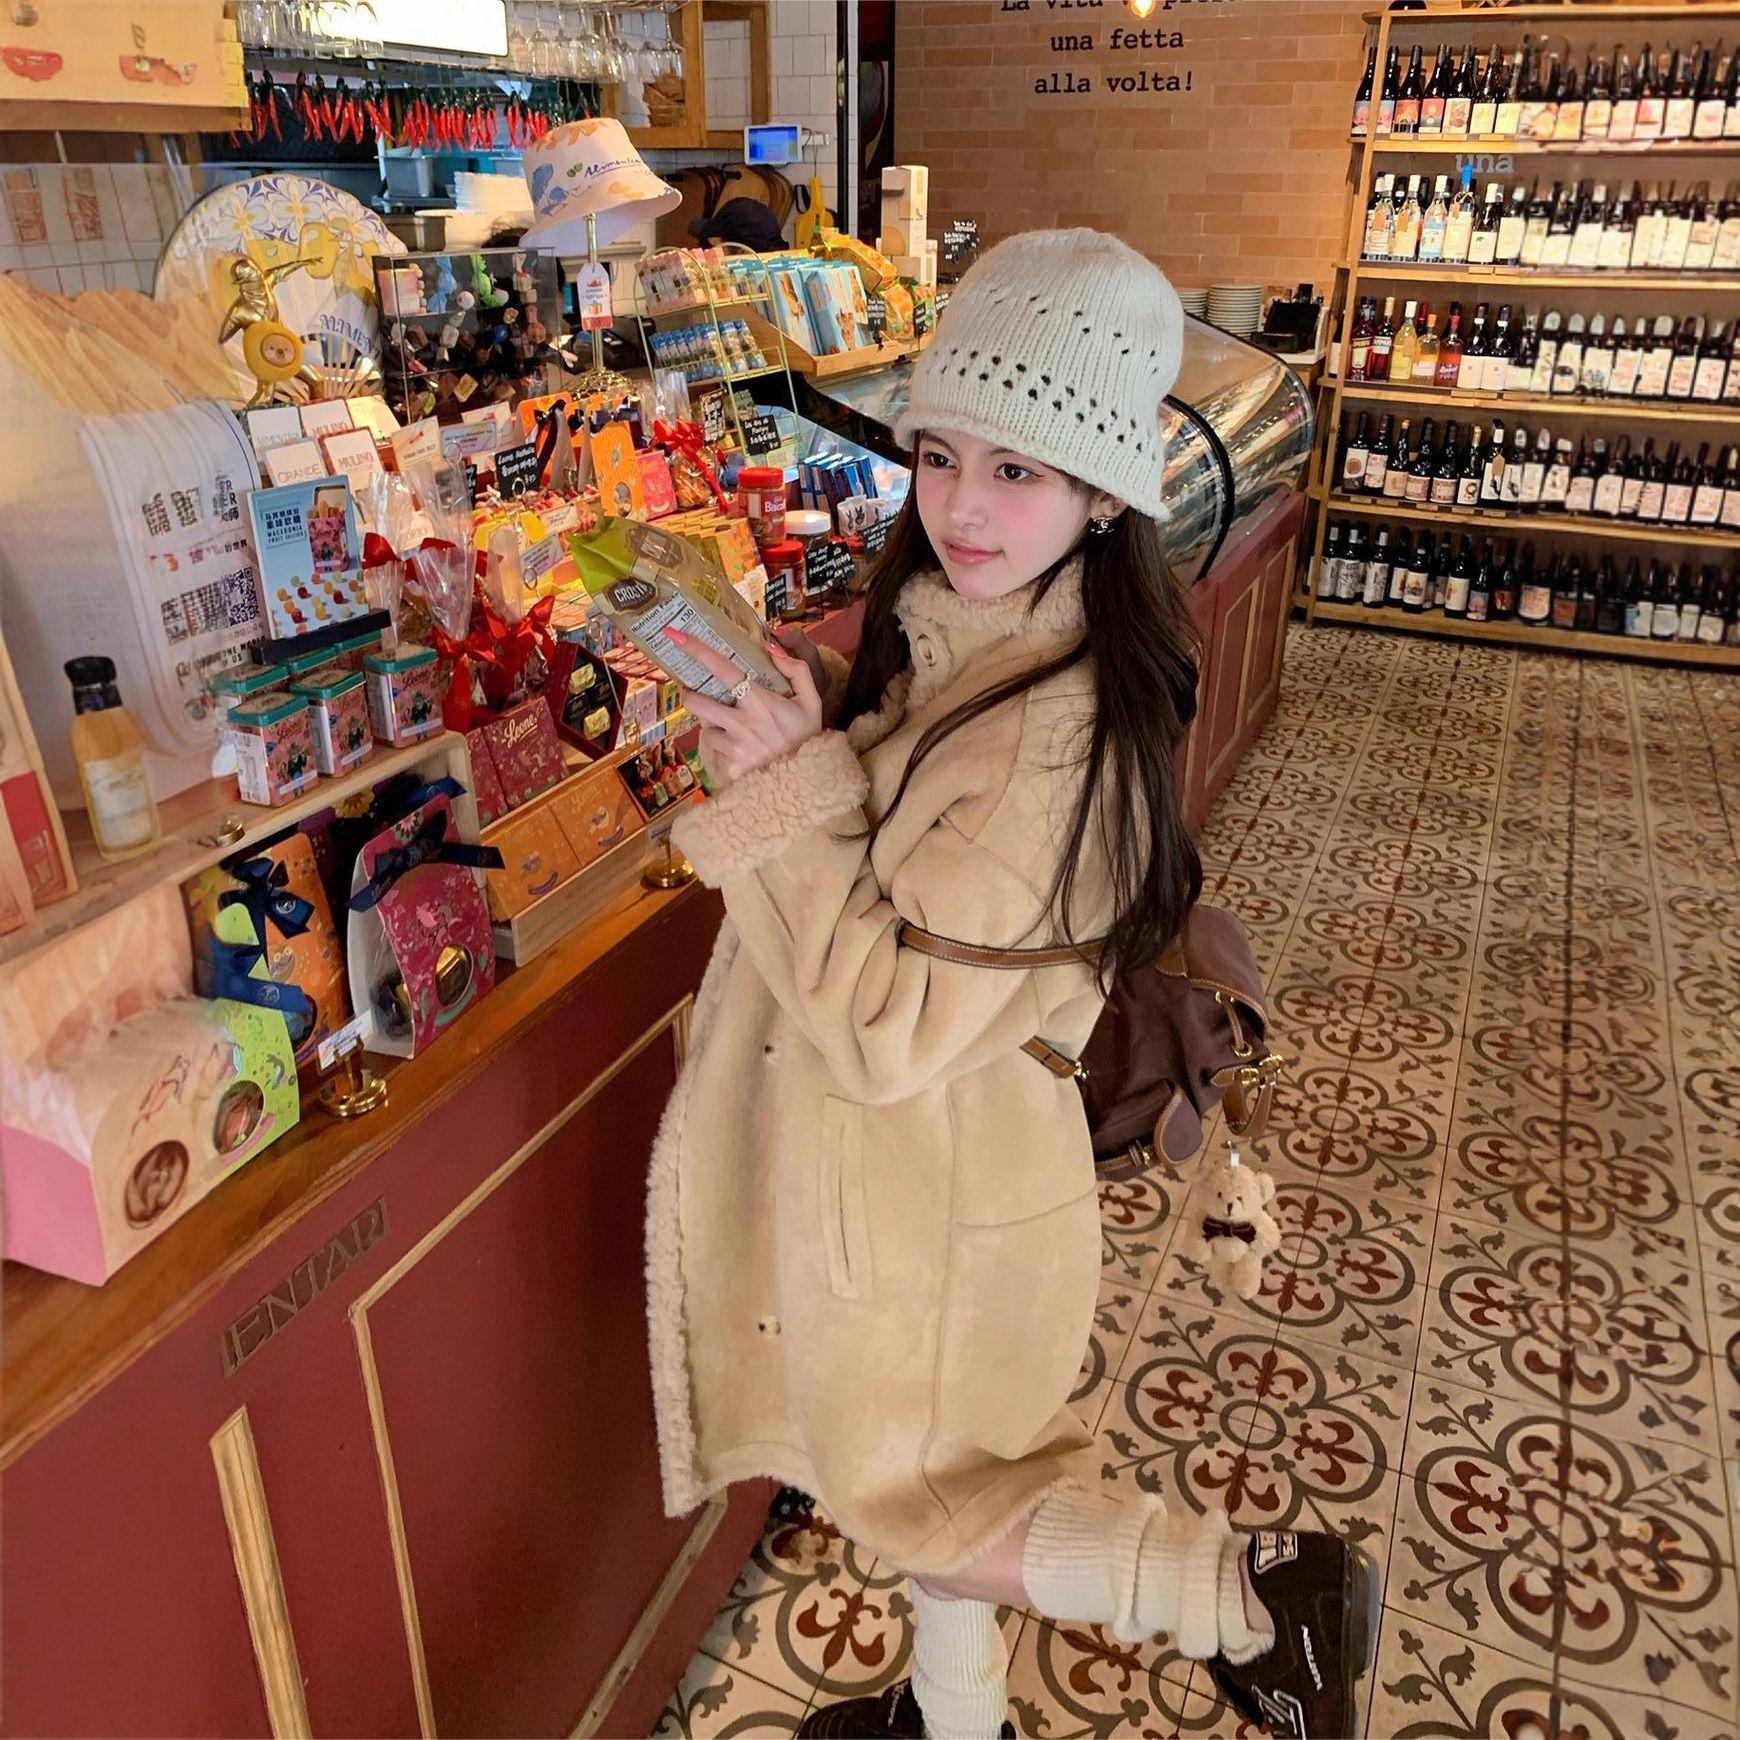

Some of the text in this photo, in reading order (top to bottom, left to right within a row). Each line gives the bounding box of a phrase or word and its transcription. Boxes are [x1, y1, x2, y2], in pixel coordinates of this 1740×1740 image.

[1050, 28, 1184, 51] una fetta
[1034, 71, 1192, 94] alla volta!
[1455, 153, 1514, 173] una
[338, 451, 374, 469] MULINO
[277, 463, 323, 483] GRANDE
[630, 607, 661, 634] Nutrition
[681, 608, 695, 623] 130
[504, 713, 538, 749] Leone
